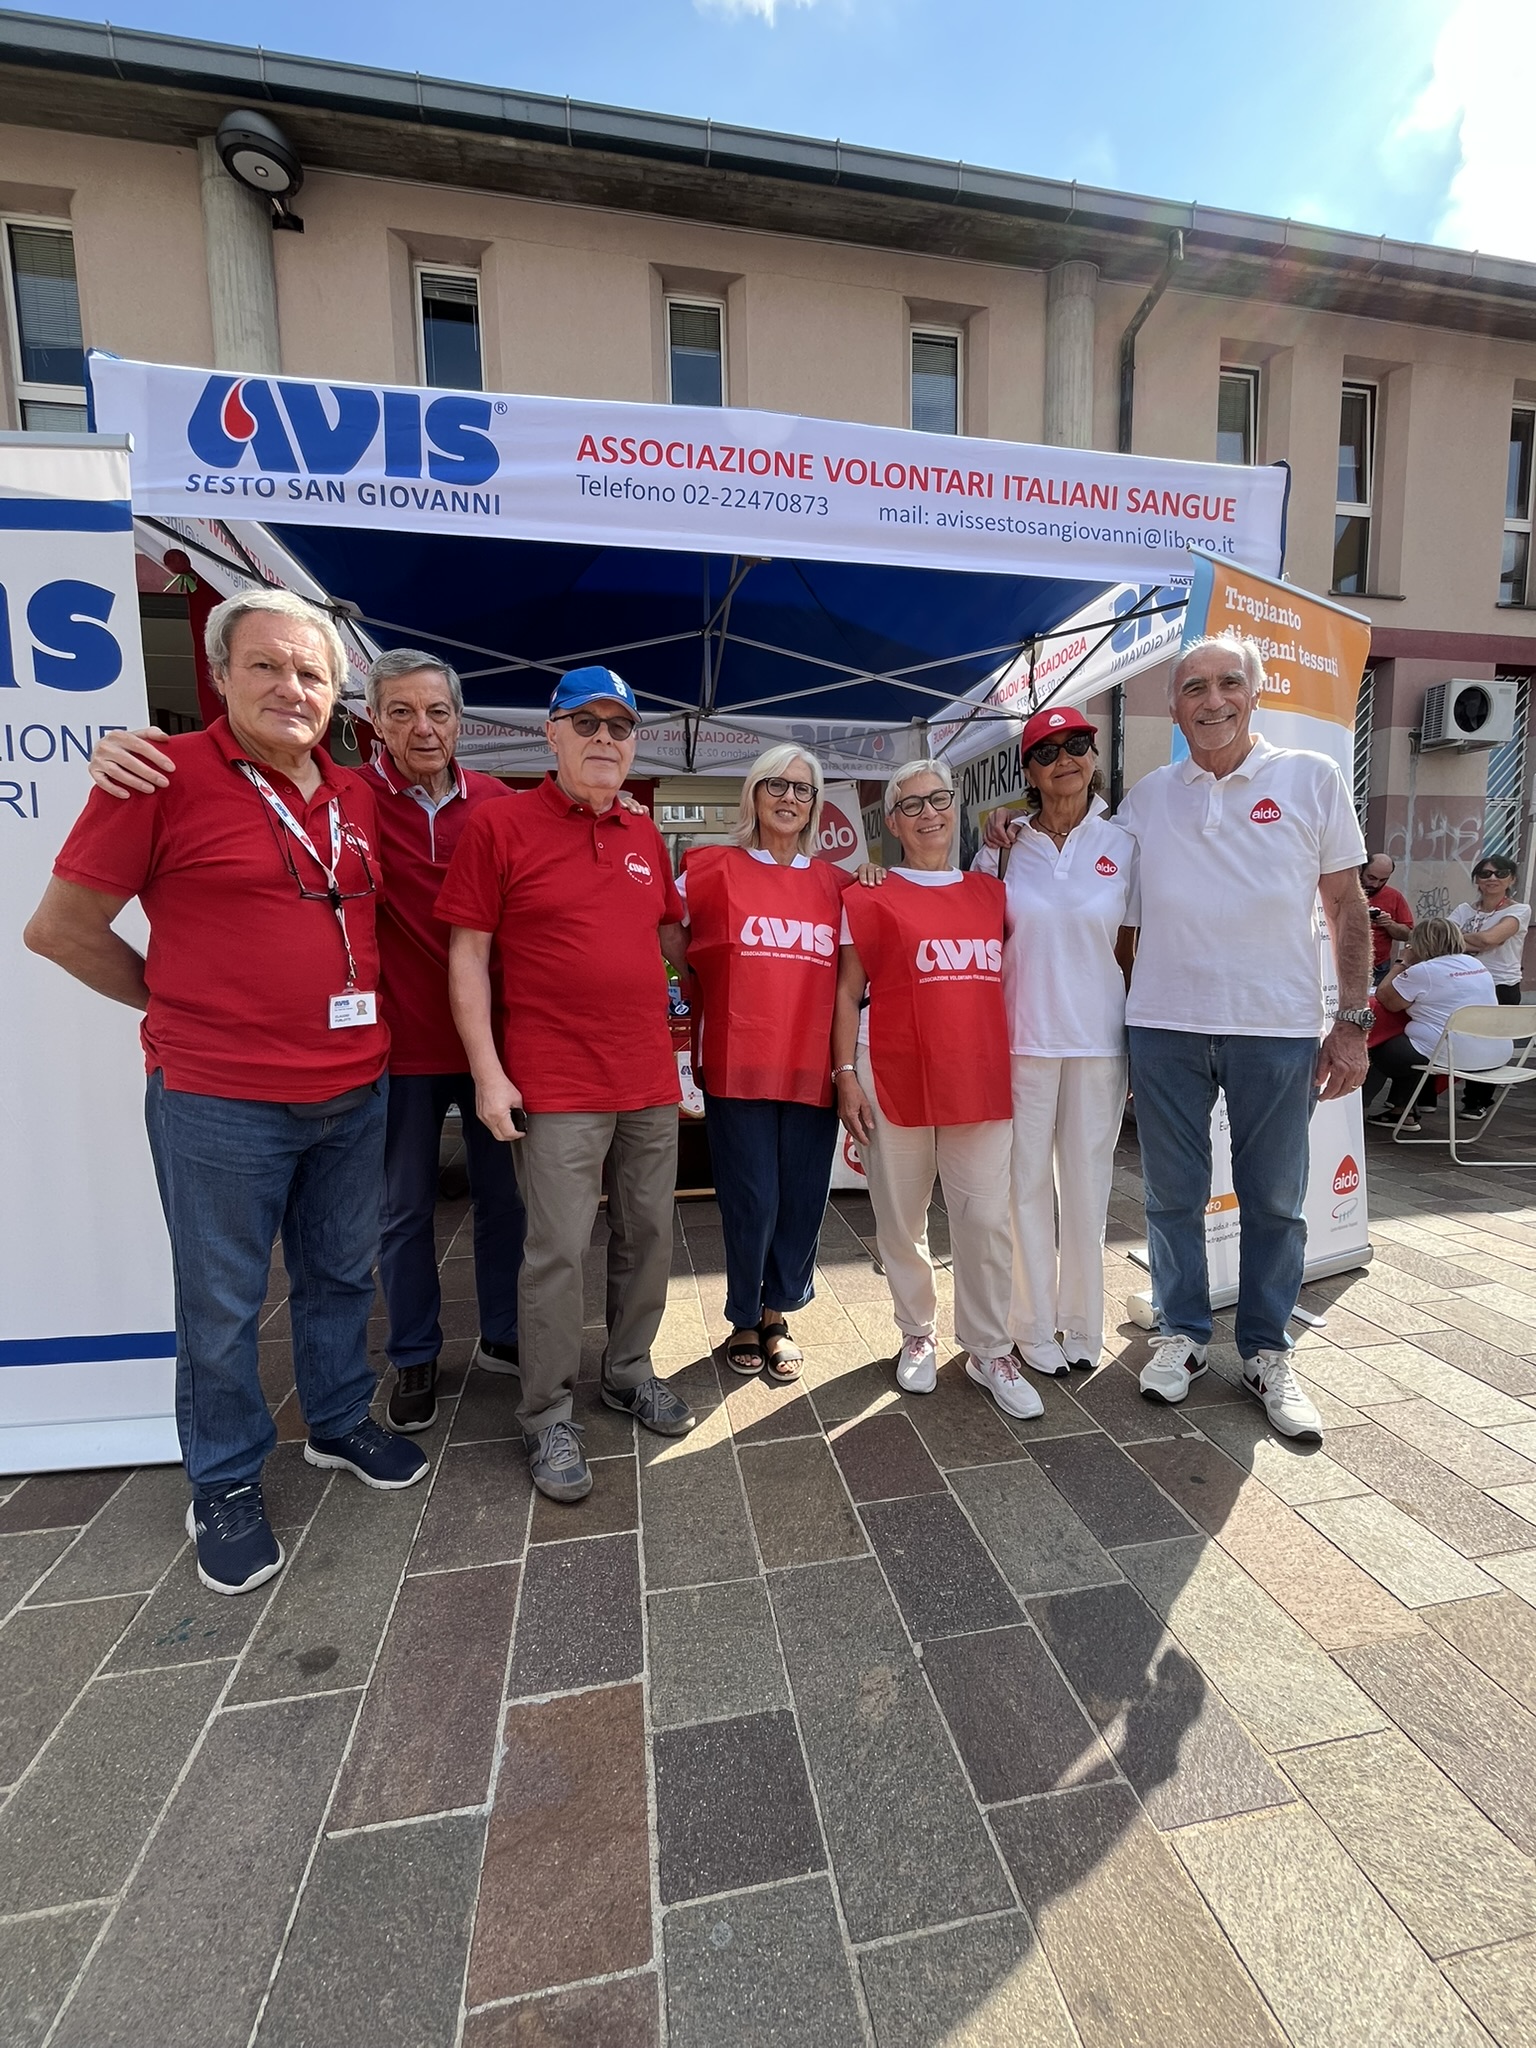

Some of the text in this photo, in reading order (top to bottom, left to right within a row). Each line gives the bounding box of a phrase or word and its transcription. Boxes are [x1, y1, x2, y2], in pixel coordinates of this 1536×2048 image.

[185, 473, 501, 515] SESTO SAN GIOVANNI
[577, 434, 1237, 523] ASSOCIAZIONE VOLONTARI ITALIANI SANGUE
[576, 474, 676, 503] Telefono
[683, 484, 829, 517] 02-22470873
[879, 505, 929, 526] mail:
[1225, 585, 1301, 631] Trapianto
[1298, 645, 1339, 678] tessuti
[1252, 806, 1280, 820] aido
[1095, 860, 1117, 873] aido
[916, 938, 1002, 973] AVIS
[1334, 1170, 1359, 1190] aido
